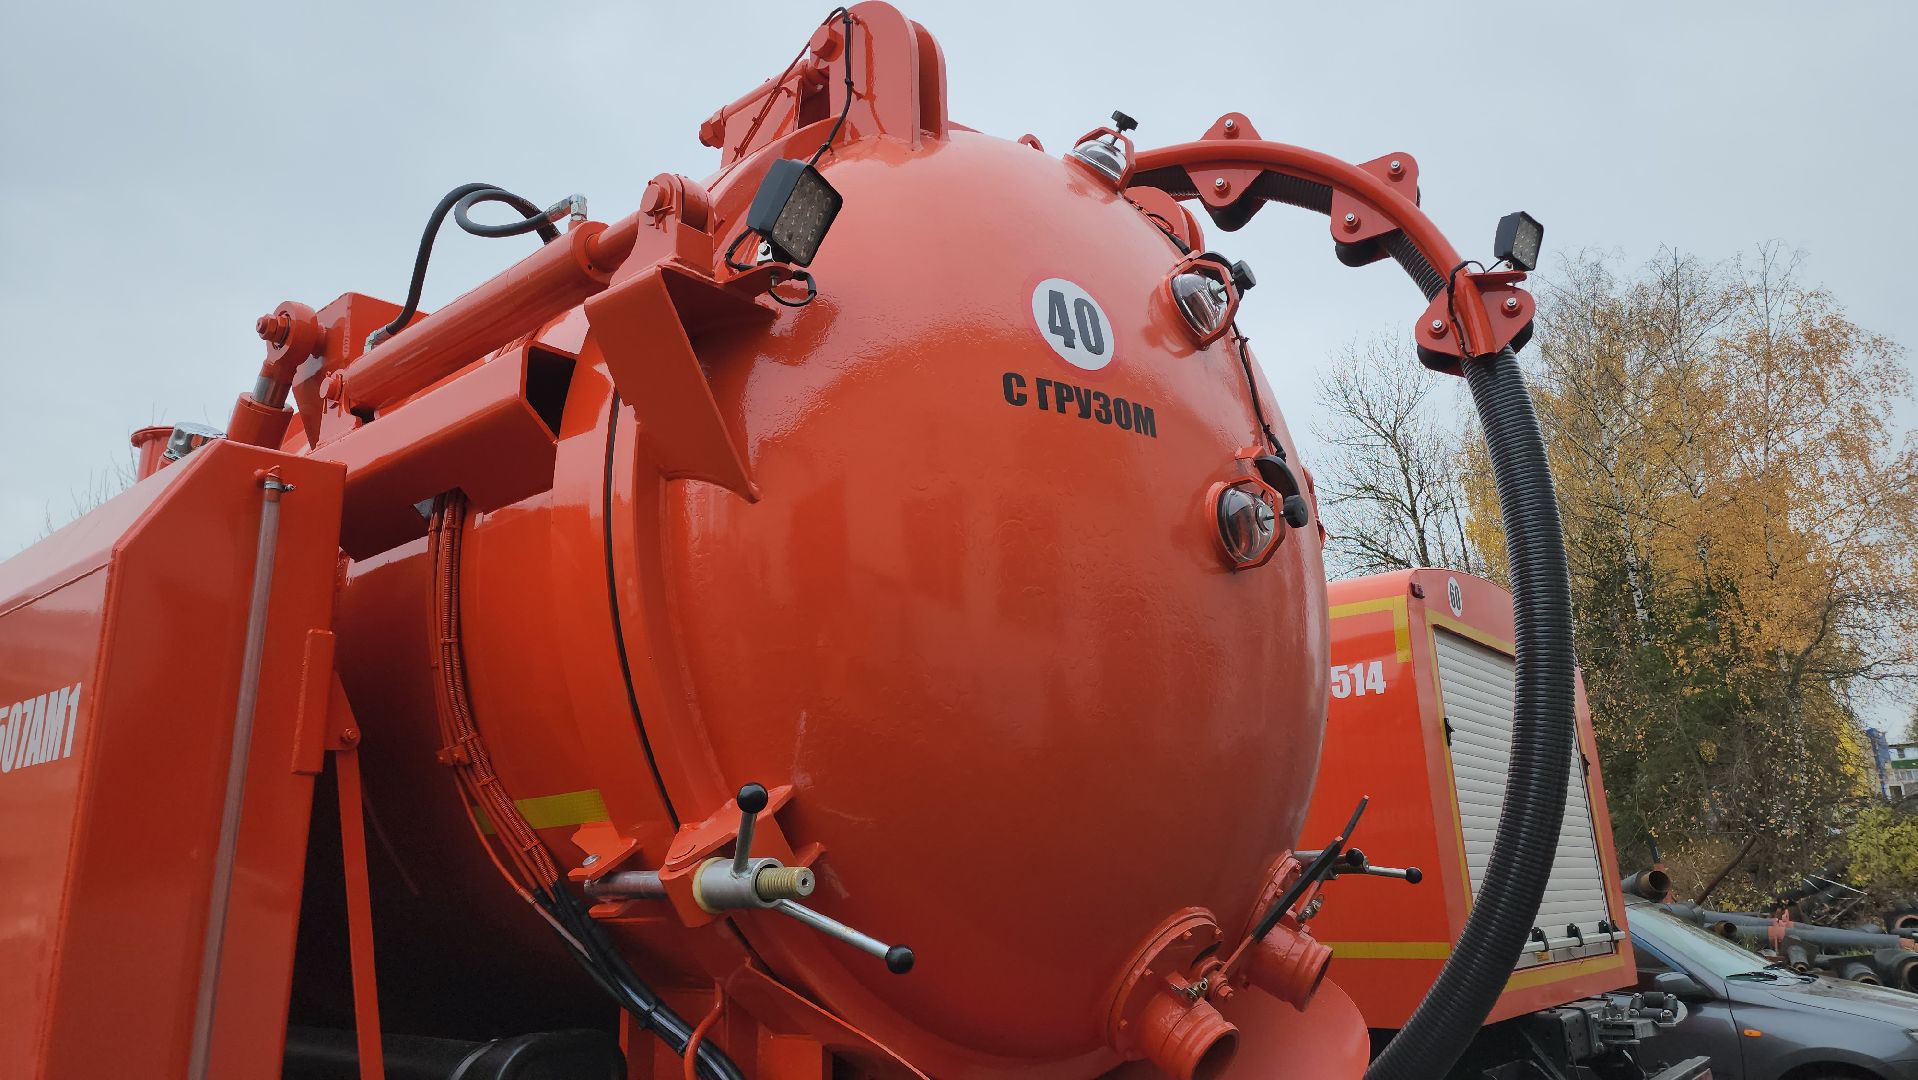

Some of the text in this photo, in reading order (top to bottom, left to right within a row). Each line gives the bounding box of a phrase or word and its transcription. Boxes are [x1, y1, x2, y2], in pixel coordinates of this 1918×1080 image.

[1048, 290, 1104, 355] 40
[1002, 372, 1157, 438] С ГРУЗОМ
[1449, 582, 1461, 611] 60
[1330, 660, 1387, 699] 514
